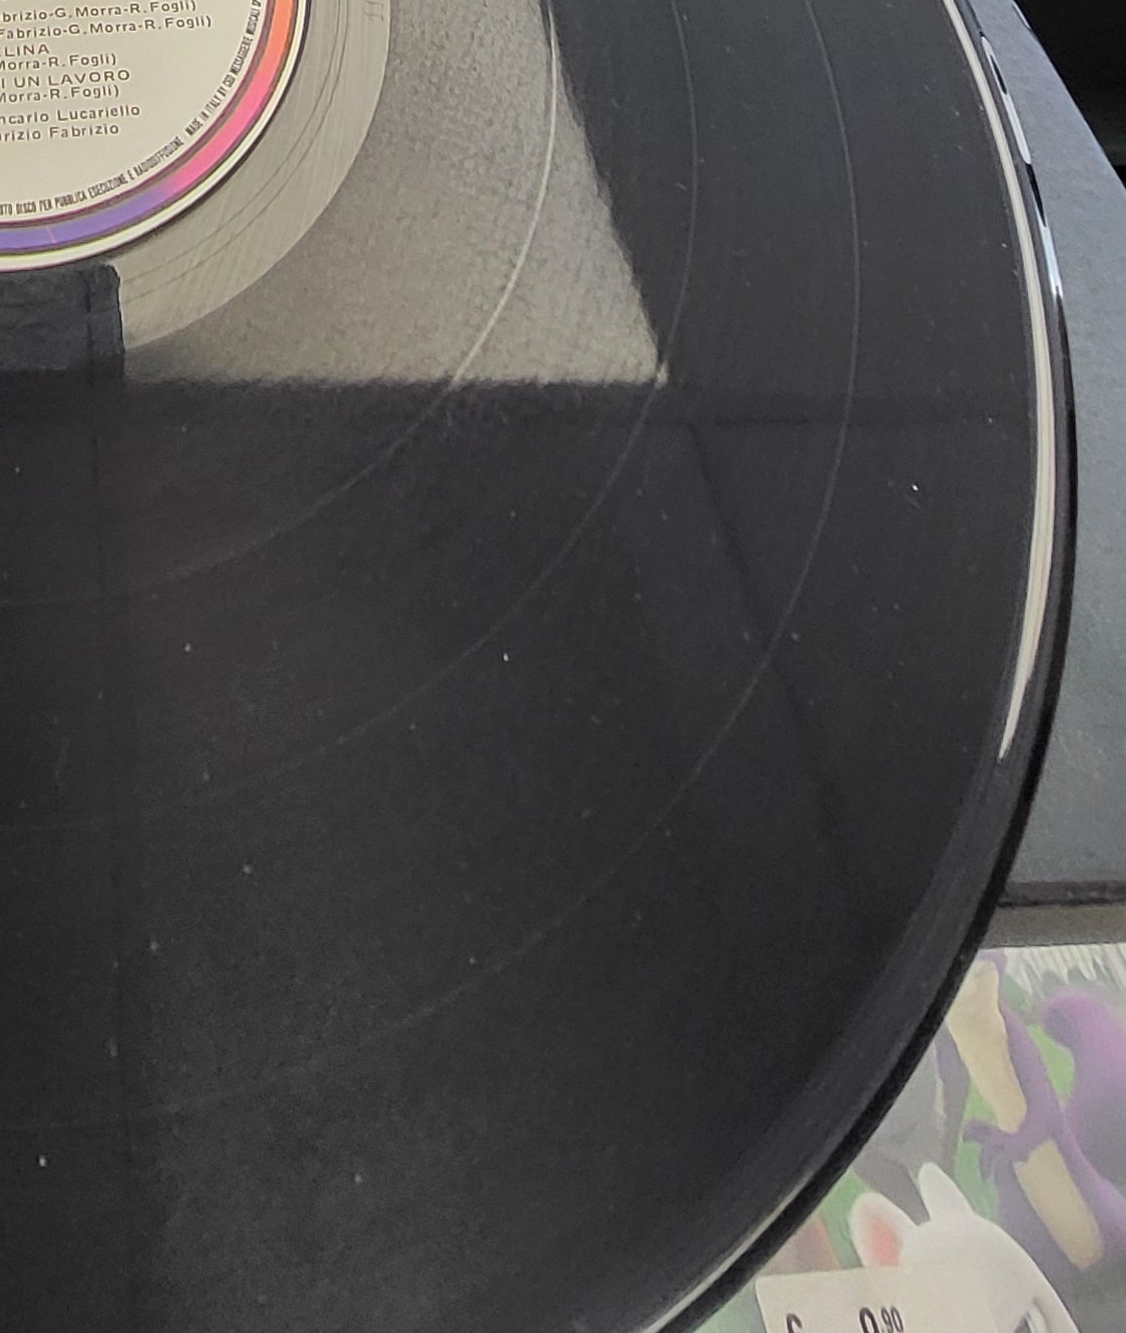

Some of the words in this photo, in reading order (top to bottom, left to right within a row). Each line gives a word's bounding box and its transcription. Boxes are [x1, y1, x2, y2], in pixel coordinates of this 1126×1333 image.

[14, 75, 40, 89] UN
[48, 69, 131, 86] LAVORO
[57, 104, 140, 123] Lucariello
[49, 122, 119, 139] Fabrizio
